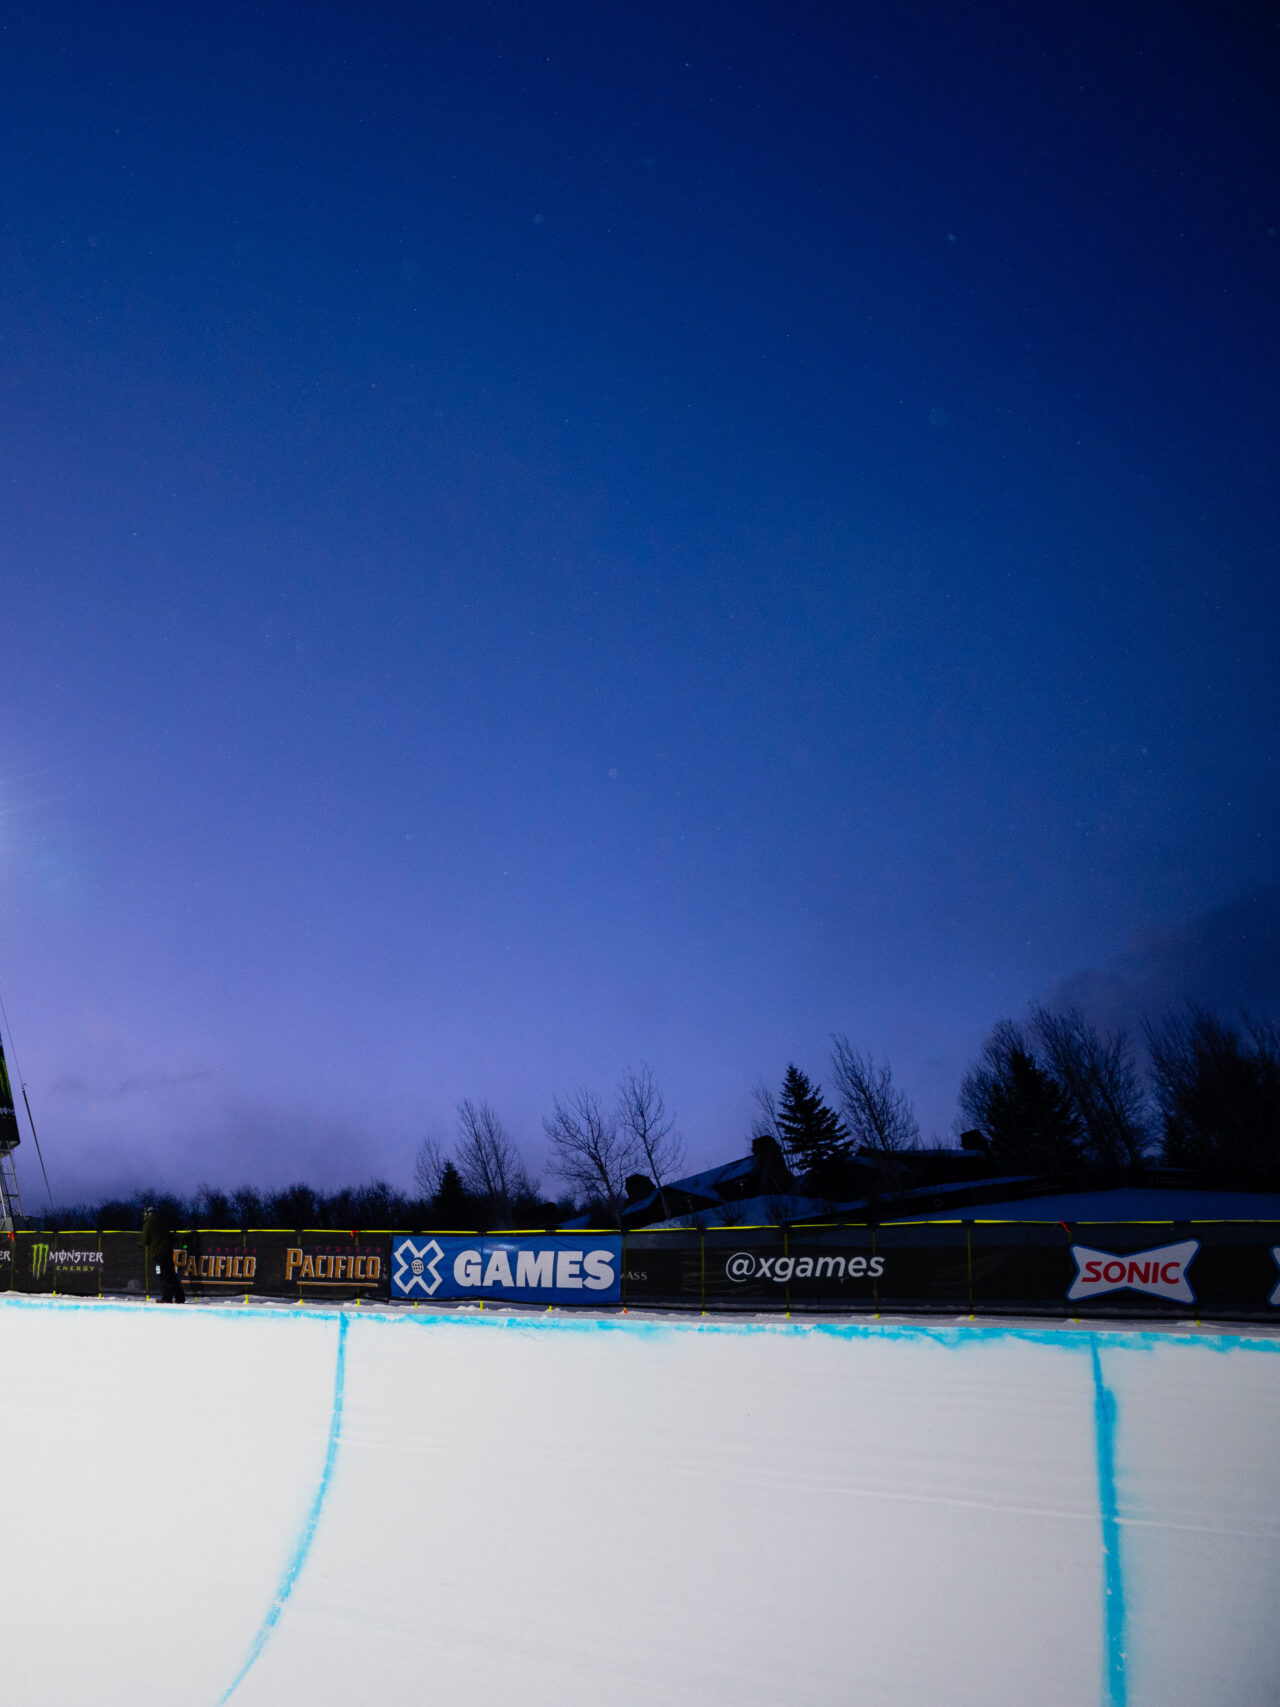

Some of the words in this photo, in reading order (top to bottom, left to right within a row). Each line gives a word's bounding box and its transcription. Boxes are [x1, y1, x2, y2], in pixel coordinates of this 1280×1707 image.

[49, 1249, 105, 1264] MONSTER
[172, 1249, 257, 1279] PACIFICO
[284, 1247, 381, 1281] PACIFICO
[453, 1249, 616, 1290] GAMES
[725, 1252, 886, 1283] @xgames
[1081, 1261, 1181, 1284] SONIC
